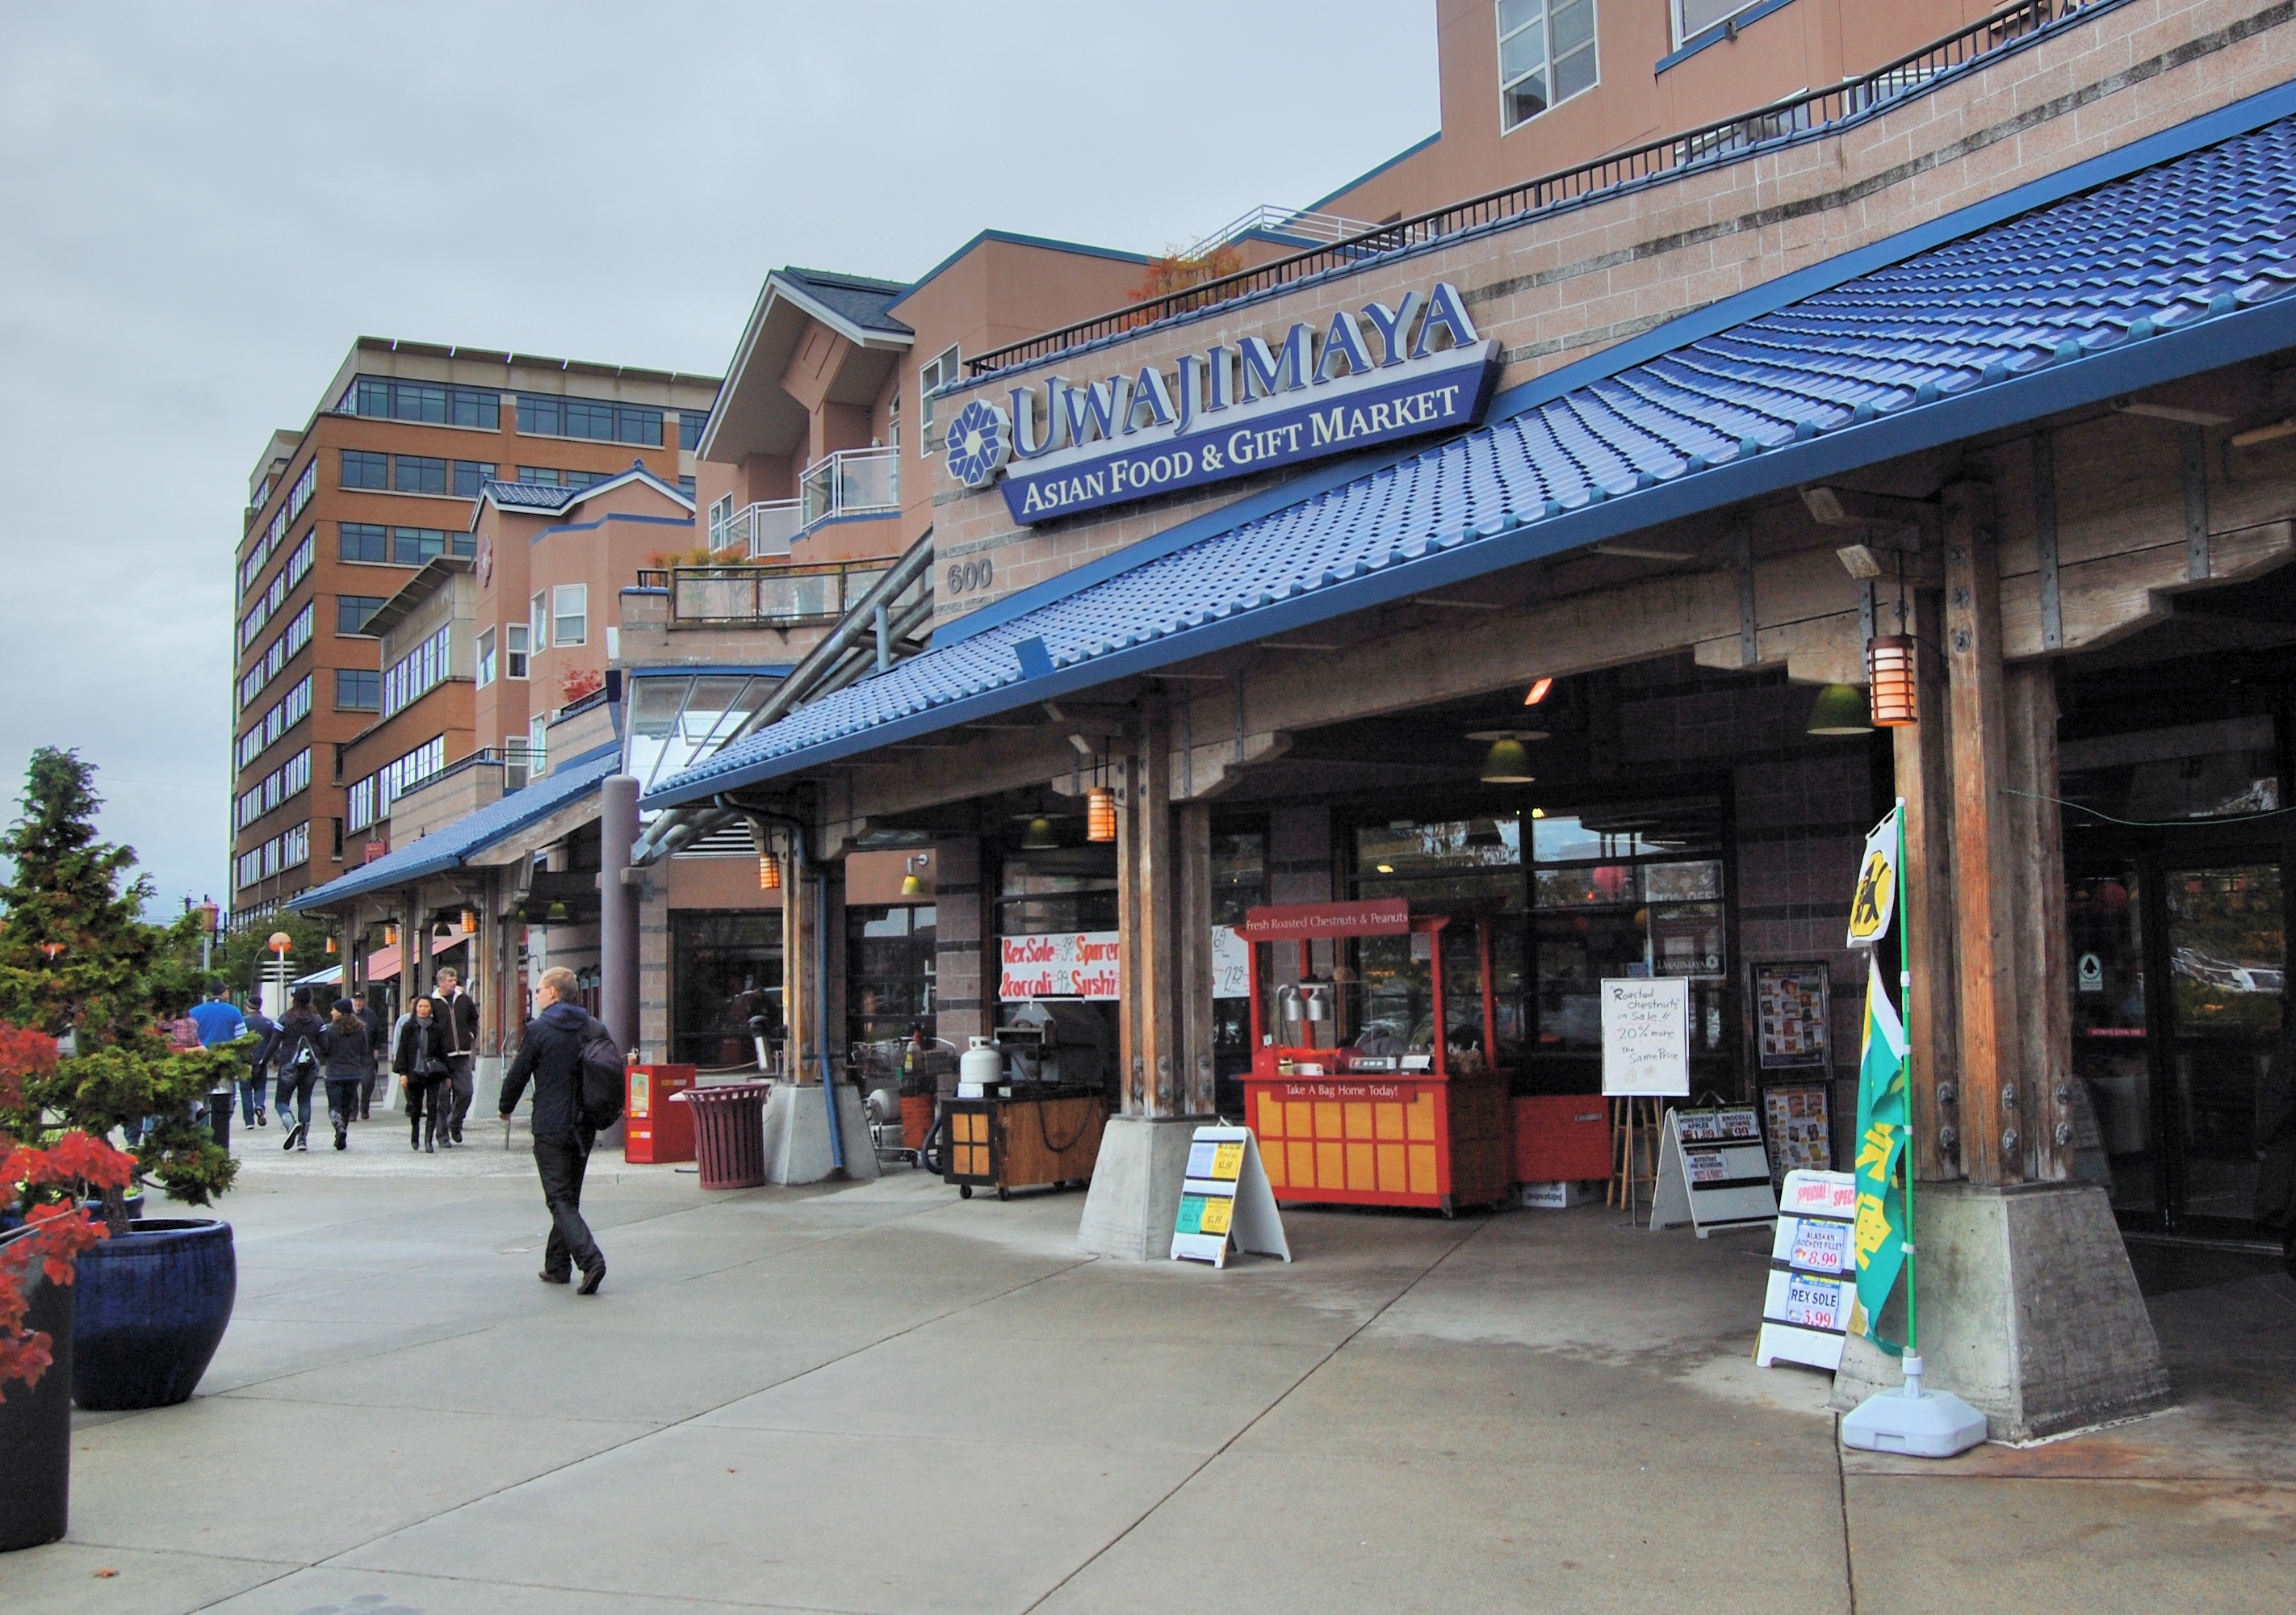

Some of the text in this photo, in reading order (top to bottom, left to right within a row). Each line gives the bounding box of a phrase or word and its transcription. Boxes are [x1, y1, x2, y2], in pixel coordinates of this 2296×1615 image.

[1009, 283, 1477, 459] UWAJIMAYA
[1022, 385, 1460, 515] ASIAN FOOD & GIFT MARKET
[948, 559, 992, 594] 600
[1246, 912, 1408, 930] Fresh Roasted Chestnuts & Peanuts
[1003, 938, 1026, 964] Rex
[1026, 937, 1055, 963] Sole
[1001, 971, 1052, 997] Broccoli
[1071, 970, 1116, 996] Sushi
[1618, 1024, 1674, 1039] 20% more
[1630, 1047, 1678, 1064] Same Price
[1286, 1084, 1398, 1098] Take A Bag Home Today!
[1797, 1239, 1842, 1251] SOCKEYE FILLET
[1807, 1231, 1835, 1242] ALASKAN
[1808, 1251, 1837, 1267] 8.99
[1791, 1289, 1837, 1307] REX SOLE
[1803, 1309, 1831, 1328] 3.99
